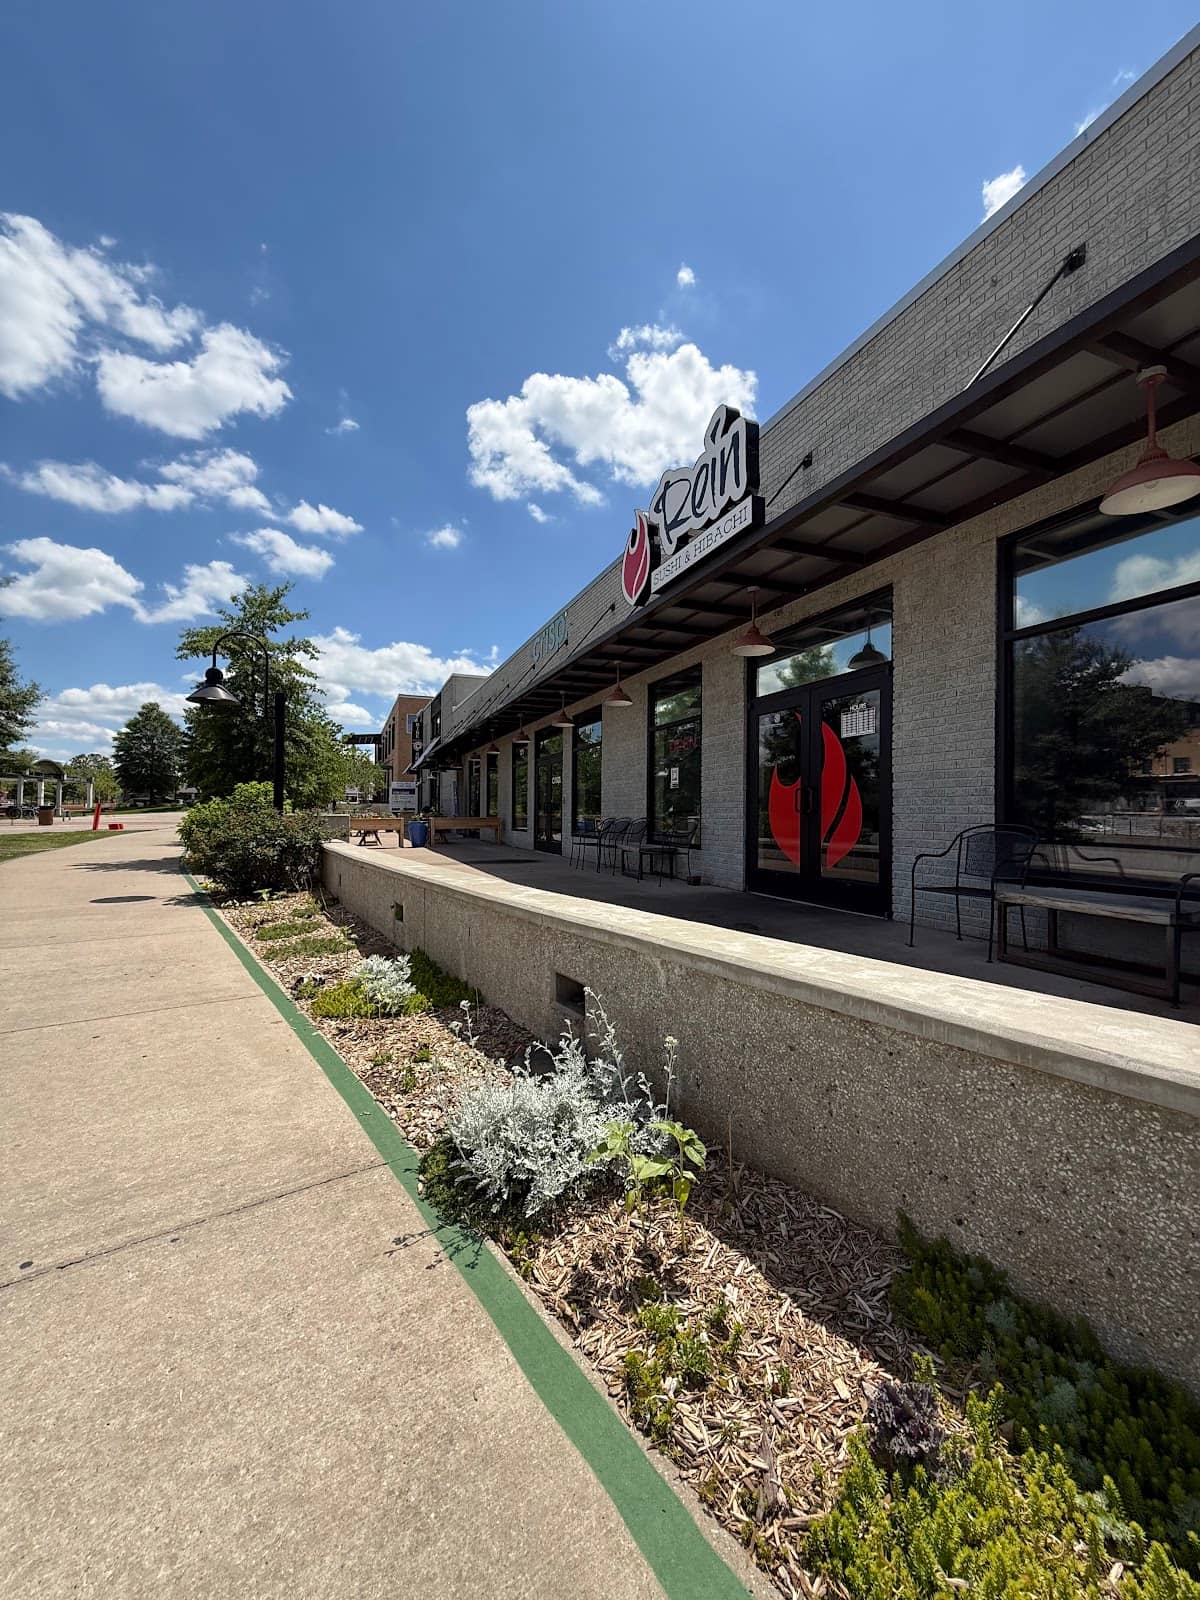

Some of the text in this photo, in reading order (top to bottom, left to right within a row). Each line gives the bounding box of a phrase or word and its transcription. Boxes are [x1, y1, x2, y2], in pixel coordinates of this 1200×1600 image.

[653, 505, 748, 585] SUSHI & HIBACHI
